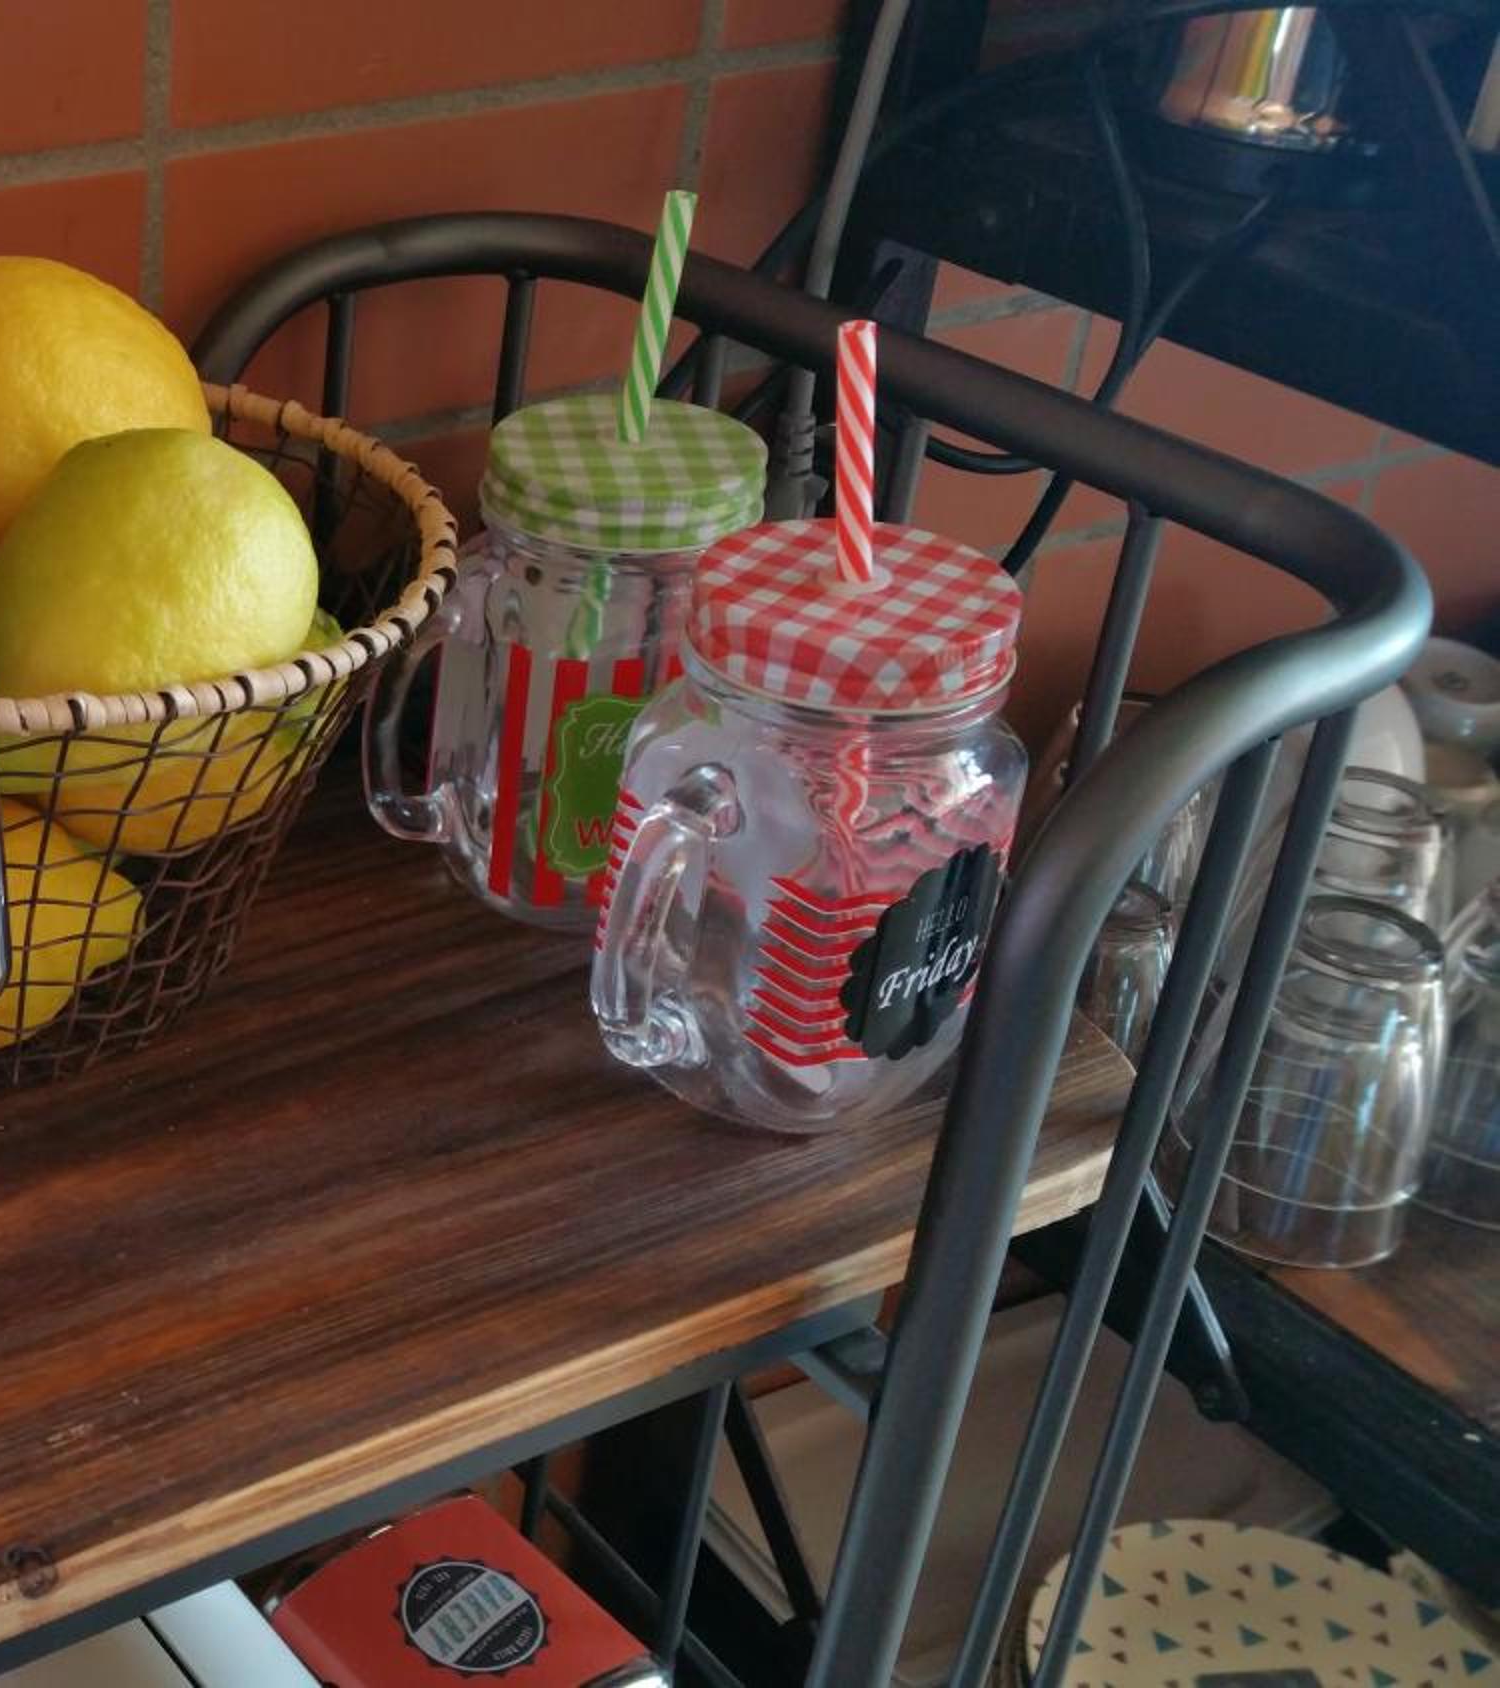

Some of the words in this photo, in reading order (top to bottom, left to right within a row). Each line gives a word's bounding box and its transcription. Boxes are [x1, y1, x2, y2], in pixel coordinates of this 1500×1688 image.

[915, 896, 970, 943] HELLO
[877, 934, 979, 1009] Friday
[427, 1574, 515, 1659] BAKERY
